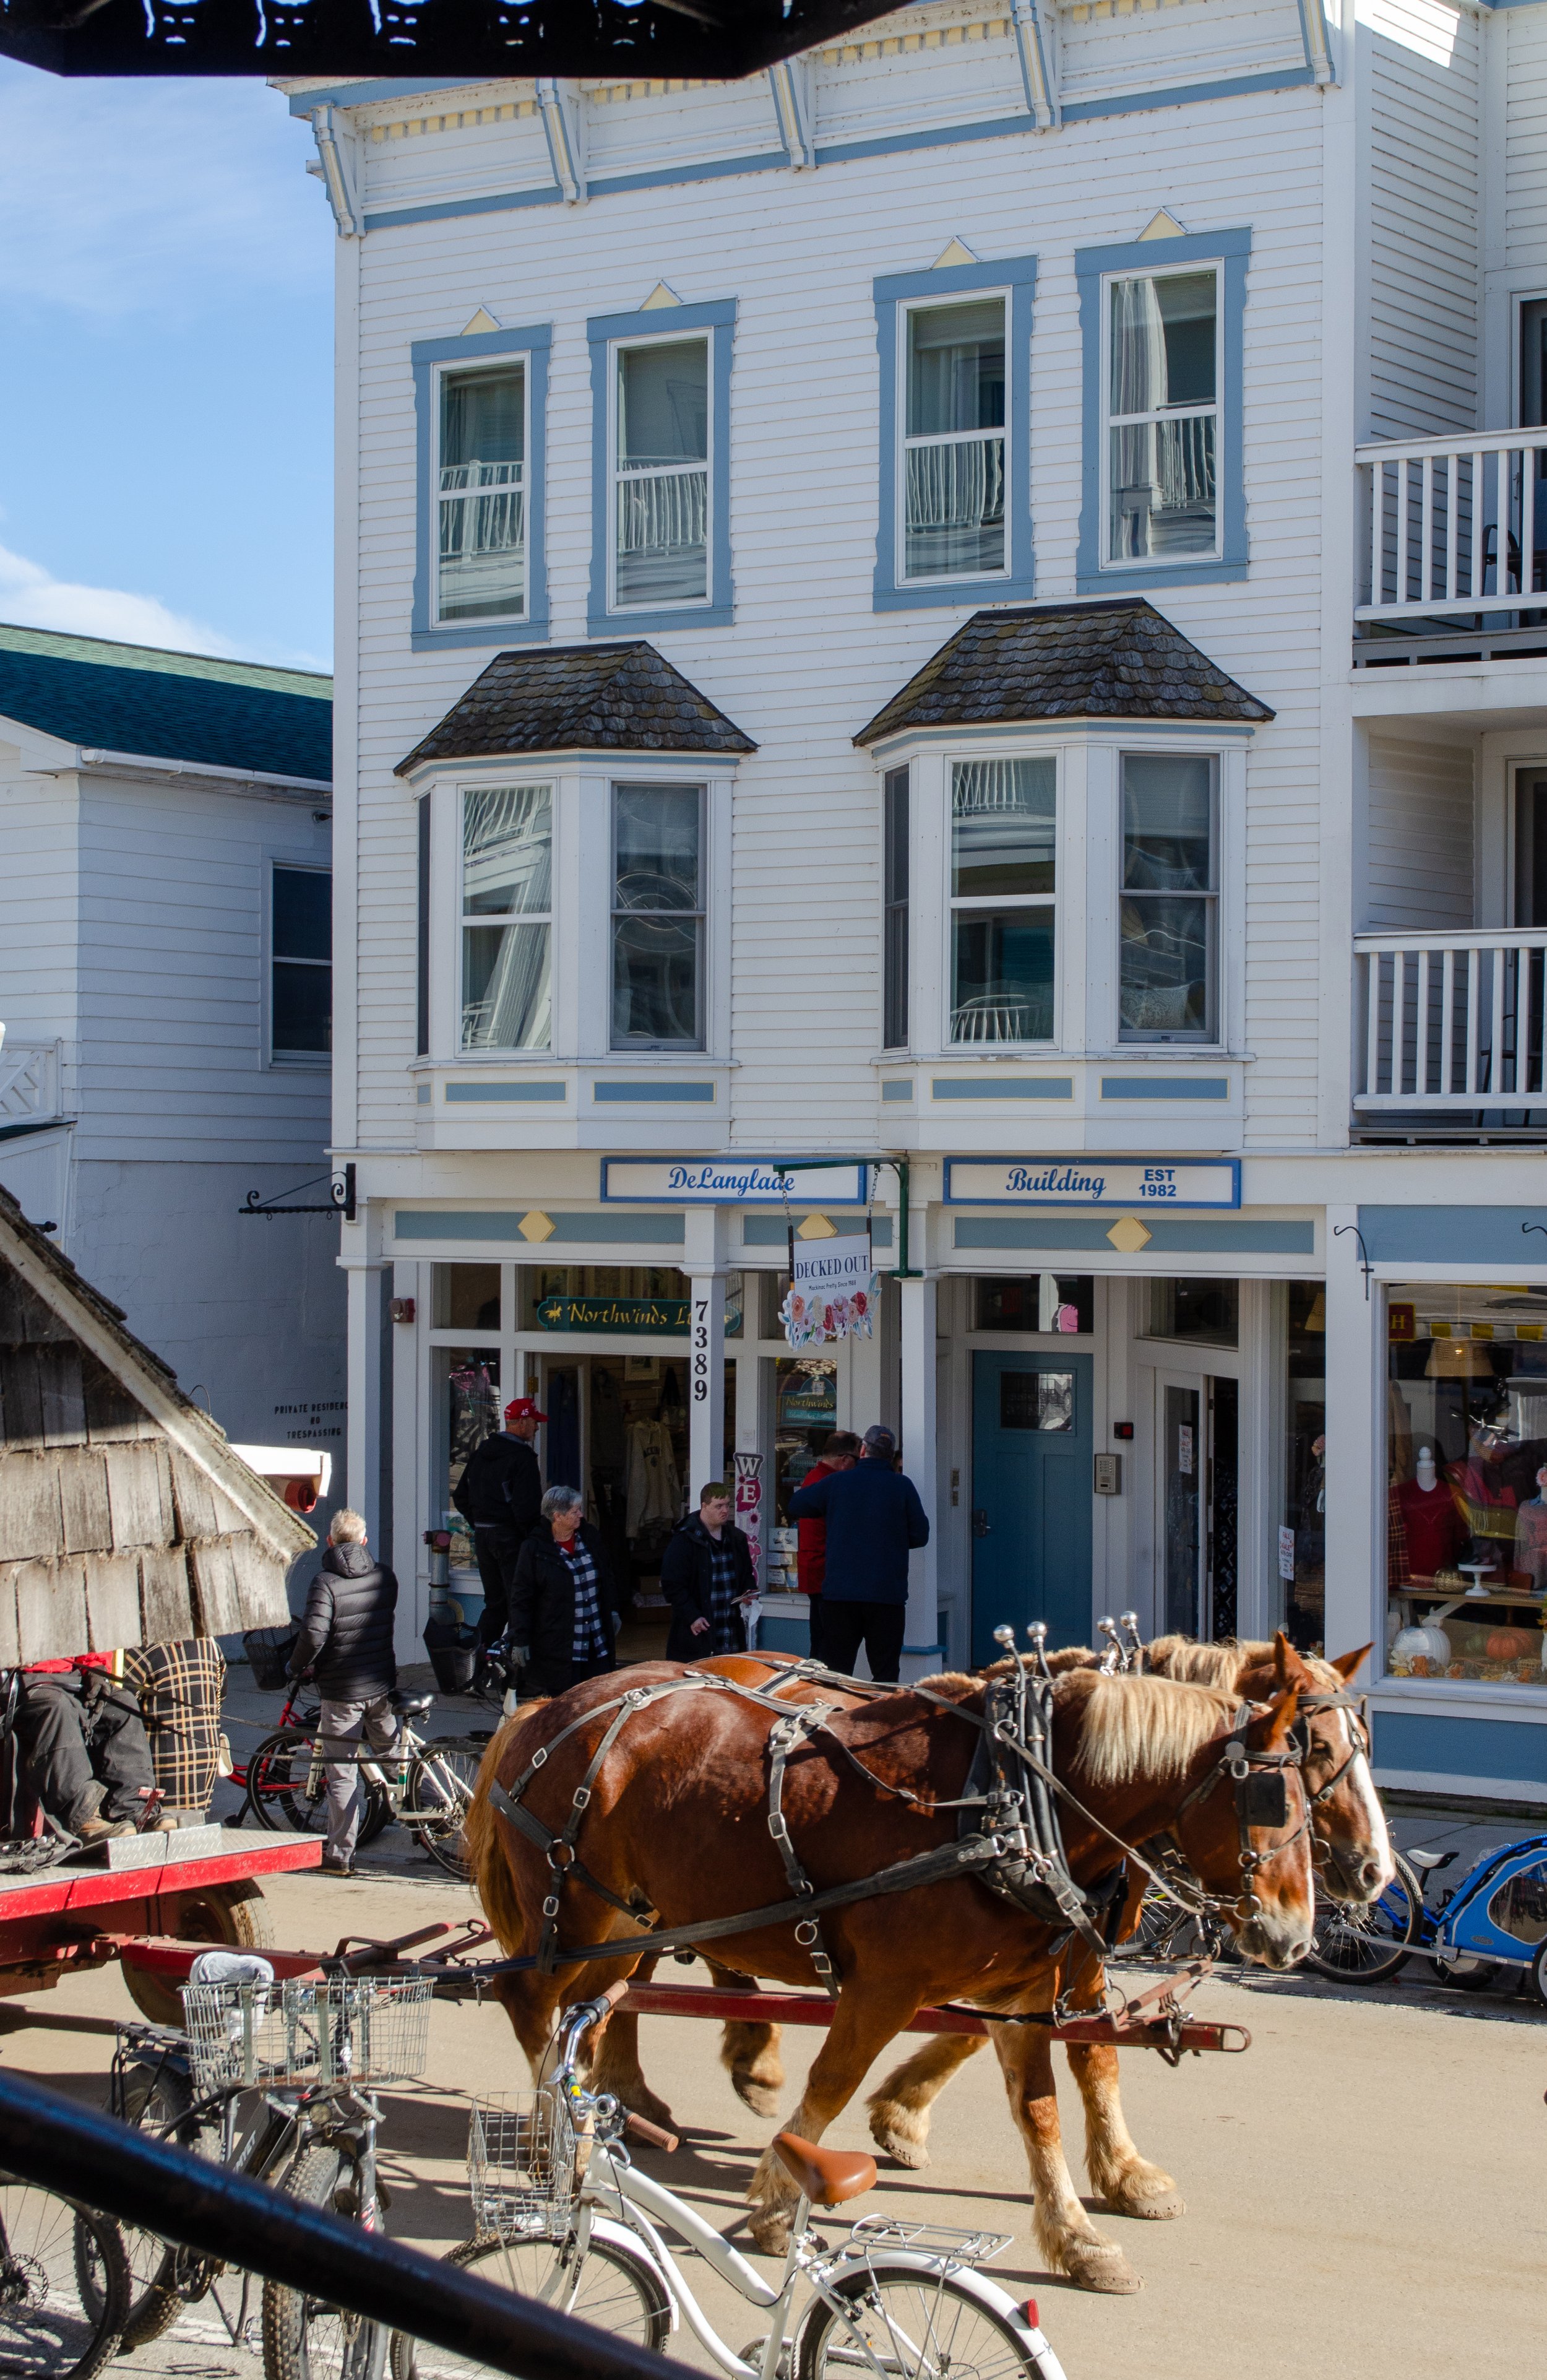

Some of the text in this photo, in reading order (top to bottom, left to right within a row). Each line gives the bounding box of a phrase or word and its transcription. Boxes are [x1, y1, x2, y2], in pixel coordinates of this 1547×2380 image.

[668, 1166, 796, 1196] DeLanglade
[1144, 1169, 1175, 1182] EST
[1006, 1167, 1106, 1199] Building
[1139, 1184, 1176, 1197] 1982
[796, 1255, 868, 1279] DECKED OUT
[567, 1303, 668, 1324] Northwinds
[694, 1300, 709, 1401] 7389
[786, 1396, 834, 1408] Northwinds
[274, 1404, 308, 1414] PRIVATE
[520, 1408, 529, 1416] 45
[311, 1416, 321, 1425] NO
[287, 1427, 341, 1439] TRESPASSING
[571, 2253, 584, 2290] WEIZE
